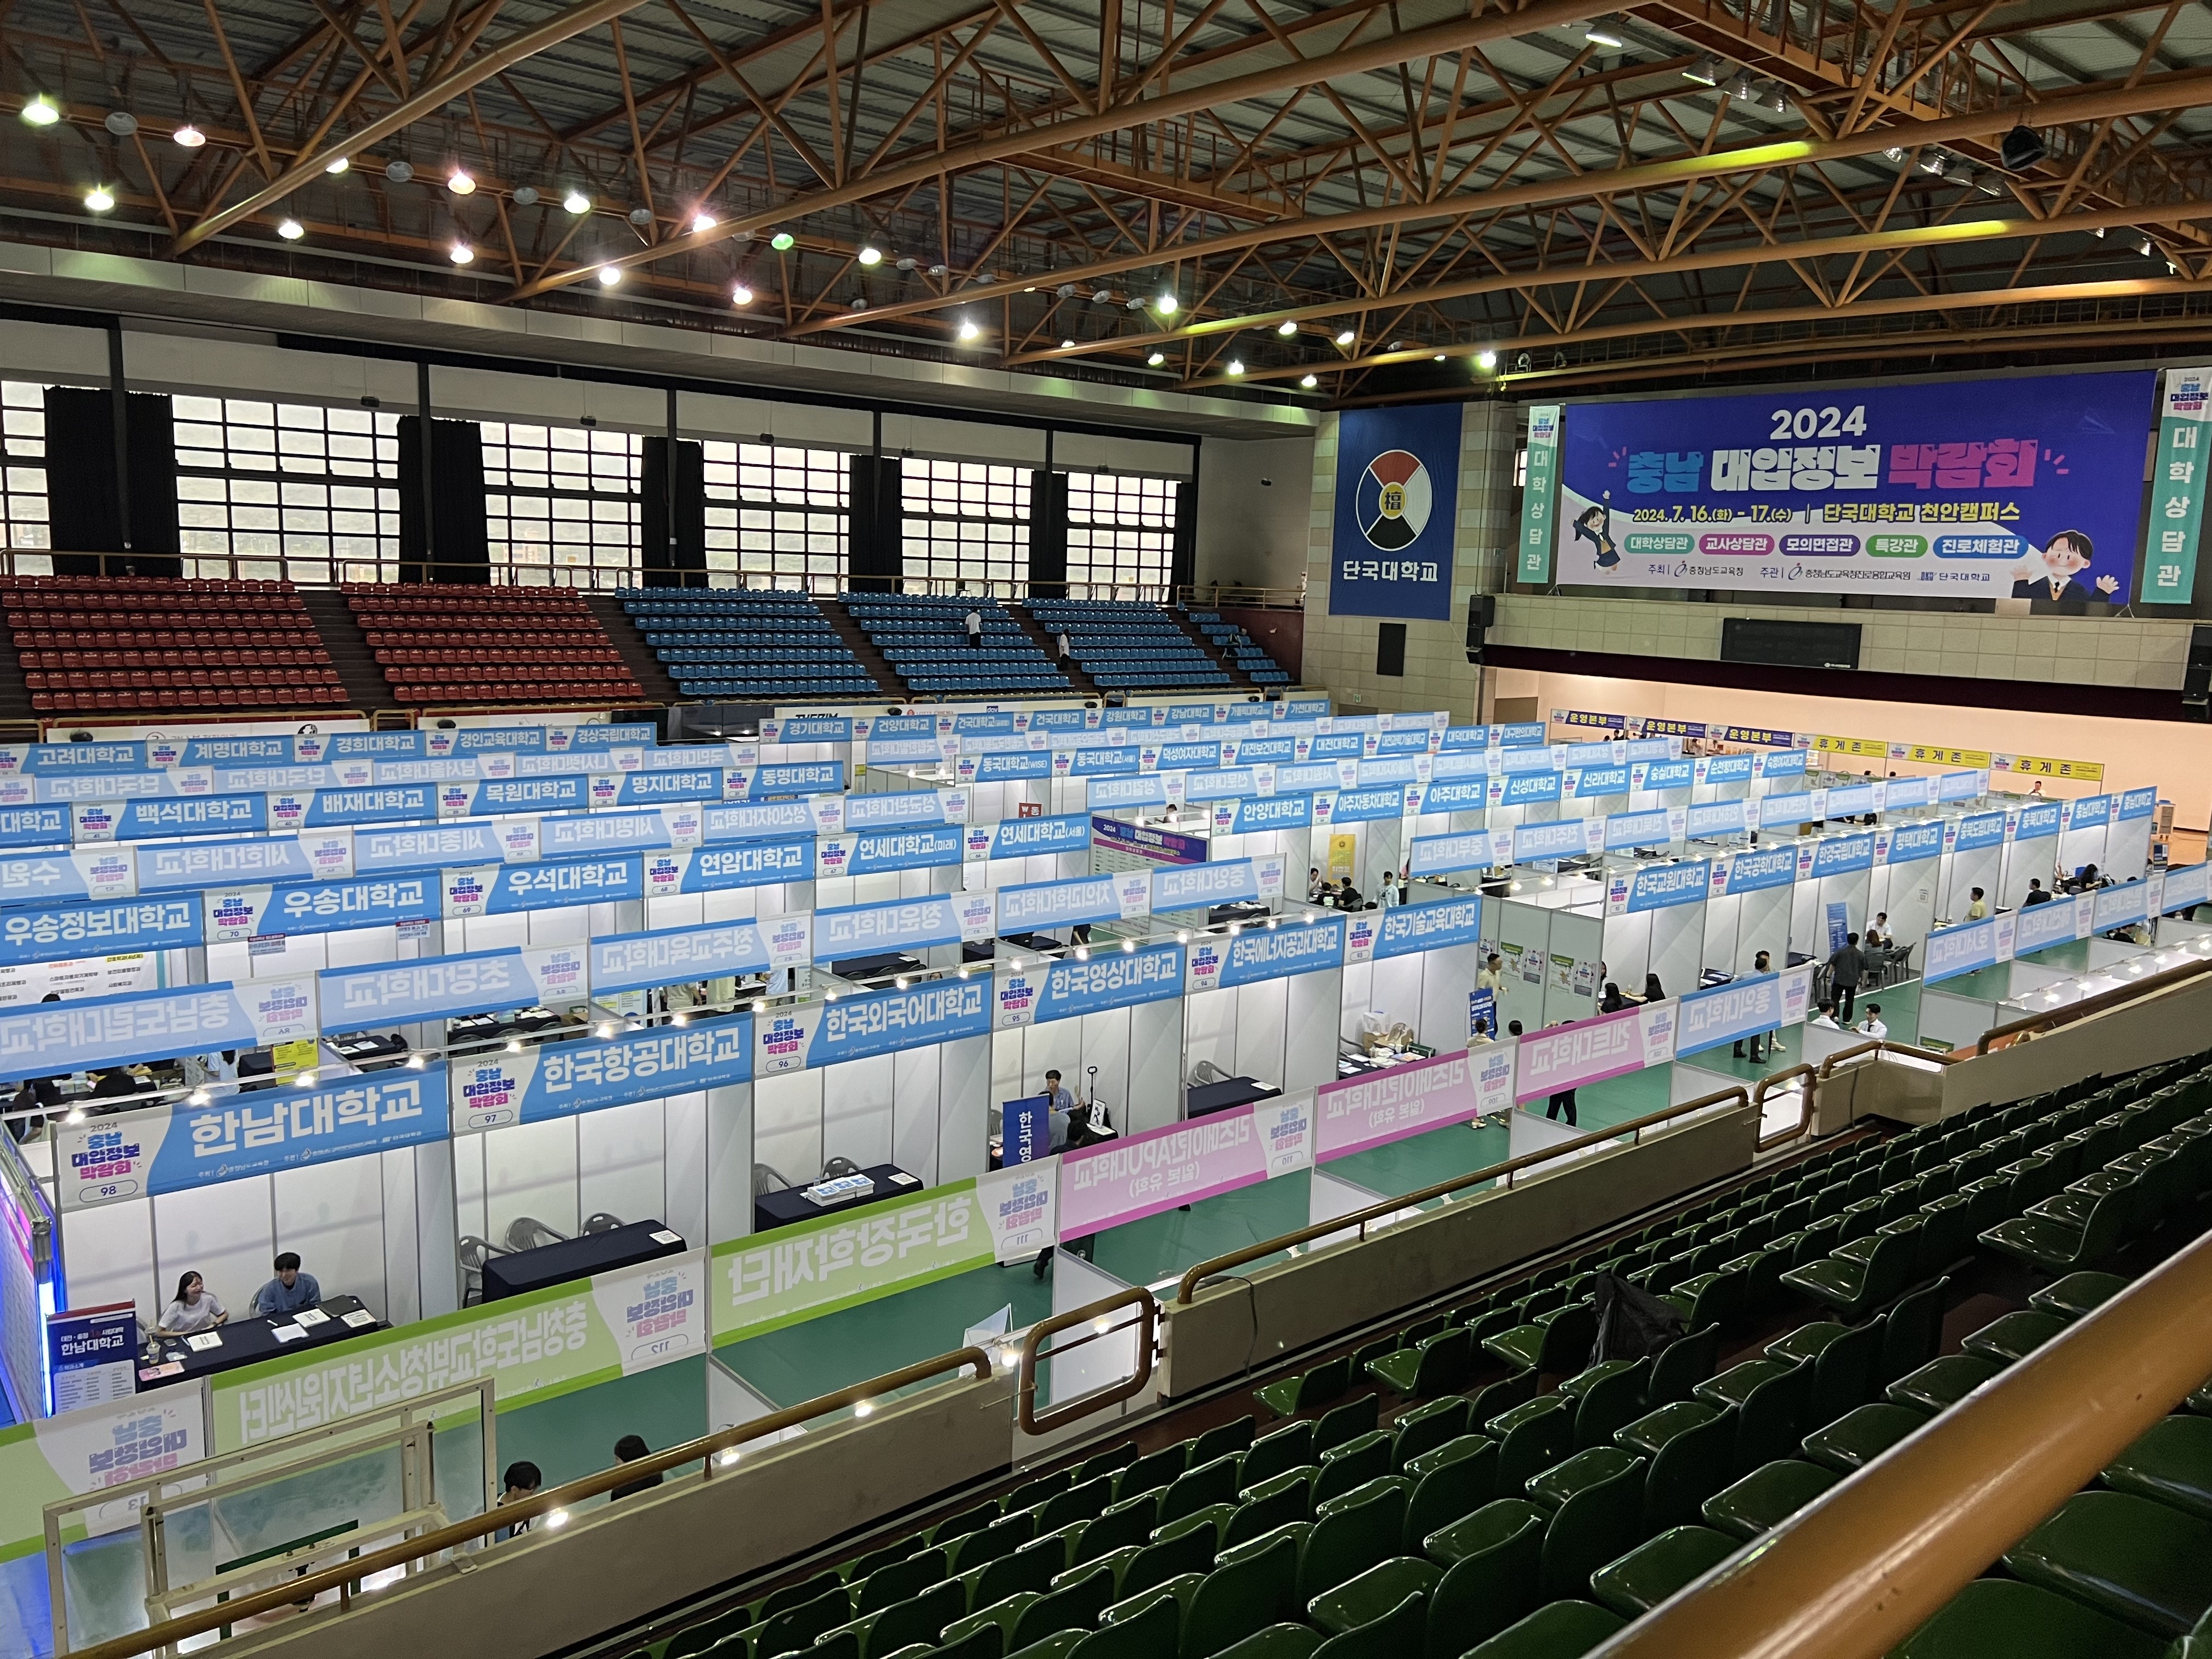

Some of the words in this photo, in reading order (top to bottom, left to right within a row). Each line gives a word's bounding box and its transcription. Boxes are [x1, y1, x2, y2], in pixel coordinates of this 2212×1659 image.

[1770, 405, 1867, 440] 2024
[1626, 451, 1704, 493] 충남
[1711, 444, 1880, 492] 대입정보
[1888, 438, 2039, 490] 박람회
[1527, 450, 1548, 571] 대학상담관
[1633, 508, 1668, 522] 2024.
[1672, 506, 1685, 521] 7.
[1823, 505, 1915, 522] 단국대학교
[1919, 502, 2021, 523] 천안캠퍼스
[2157, 427, 2198, 586] 대학상담관
[1630, 537, 1689, 550] 대학상담관
[1705, 537, 1768, 552] 교사상담관
[1786, 538, 1854, 553] 모의면접관
[1875, 538, 1918, 554] 특강관
[1941, 538, 2021, 555] 진로체험관
[1342, 561, 1438, 582] 단국대학교
[1648, 564, 1665, 575] 주최
[1760, 566, 1779, 578] 주관
[1939, 572, 1990, 582] 단국대학교
[1107, 710, 1146, 722] 강원대학교
[1171, 707, 1209, 719] 강남대학교
[1291, 703, 1325, 714] 가천대학교
[789, 721, 844, 735] 경기대학교
[879, 719, 929, 732] 건양대학교
[1036, 713, 1079, 726] 건국대학교
[1570, 713, 1607, 726] 운영본부
[1646, 720, 1687, 735] 운영본부
[460, 730, 540, 748] 경인교육대학교
[578, 727, 650, 743] 경상국립대학교
[1317, 737, 1358, 751] 대전대학교
[1447, 729, 1484, 743] 대덕대학교
[1729, 729, 1771, 743] 운영본부
[195, 741, 283, 759] 계명대학교
[336, 736, 415, 753] 경희대학교
[1163, 746, 1216, 760] 덕성여자대학교
[1241, 741, 1291, 756] 대전보건대학교
[1819, 738, 1862, 752] 휴게존
[37, 747, 134, 765] 고려대학교
[983, 755, 1047, 772] 동국대학교(WISE)
[1915, 748, 1962, 763] 휴게존
[1650, 764, 1689, 781] 숭실대학교
[1711, 758, 1750, 776] 순천향대학교
[2019, 759, 2072, 776] 휴게존
[632, 773, 712, 794] 명지대학교
[761, 767, 834, 786] 동명대학교
[1583, 770, 1626, 788] 신라대학교
[486, 781, 576, 803] 목원대학교
[1430, 784, 1480, 803] 아주대학교
[1510, 777, 1555, 795] 신성대학교
[323, 790, 424, 813] 배재대학교
[1339, 791, 1399, 811] 아주자동차대학교
[136, 800, 252, 825] 백석대학교
[1243, 799, 1305, 822] 안양대학교
[1000, 821, 1085, 845] 연세대학교(서울)
[1896, 827, 1938, 851] 평택대학교
[860, 833, 956, 860] 연세대학교(미래)
[1819, 838, 1871, 866] 한경국립대학교
[699, 845, 802, 877] 연암대학교
[1734, 852, 1793, 881] 한국공학대학교
[508, 862, 628, 896] 우석대학교
[1637, 866, 1705, 898] 한국교원대학교
[284, 881, 423, 918] 우송대학교
[5, 902, 190, 946] 우송정보대학교
[1384, 903, 1475, 941] 한국기술교육대학교
[1232, 924, 1338, 968] 한국에너지공과대학교
[1051, 952, 1176, 1000] 한국영상대학교
[826, 984, 982, 1042] 한국외국어대학교
[477, 1059, 499, 1067] 2024
[544, 1027, 740, 1094] 한국항공대학교
[778, 1060, 788, 1068] 96
[475, 1068, 501, 1082] 충남
[463, 1079, 515, 1098] 대입정보
[469, 1092, 509, 1109] 박람회
[91, 1122, 118, 1132] 2024
[190, 1080, 422, 1158] 한남대학교
[484, 1114, 496, 1124] 97
[87, 1132, 122, 1149] 충남
[71, 1143, 140, 1167] 대입정보
[80, 1160, 132, 1180] 박람회
[100, 1186, 117, 1197] 98
[61, 1335, 124, 1356] 한남대학교
